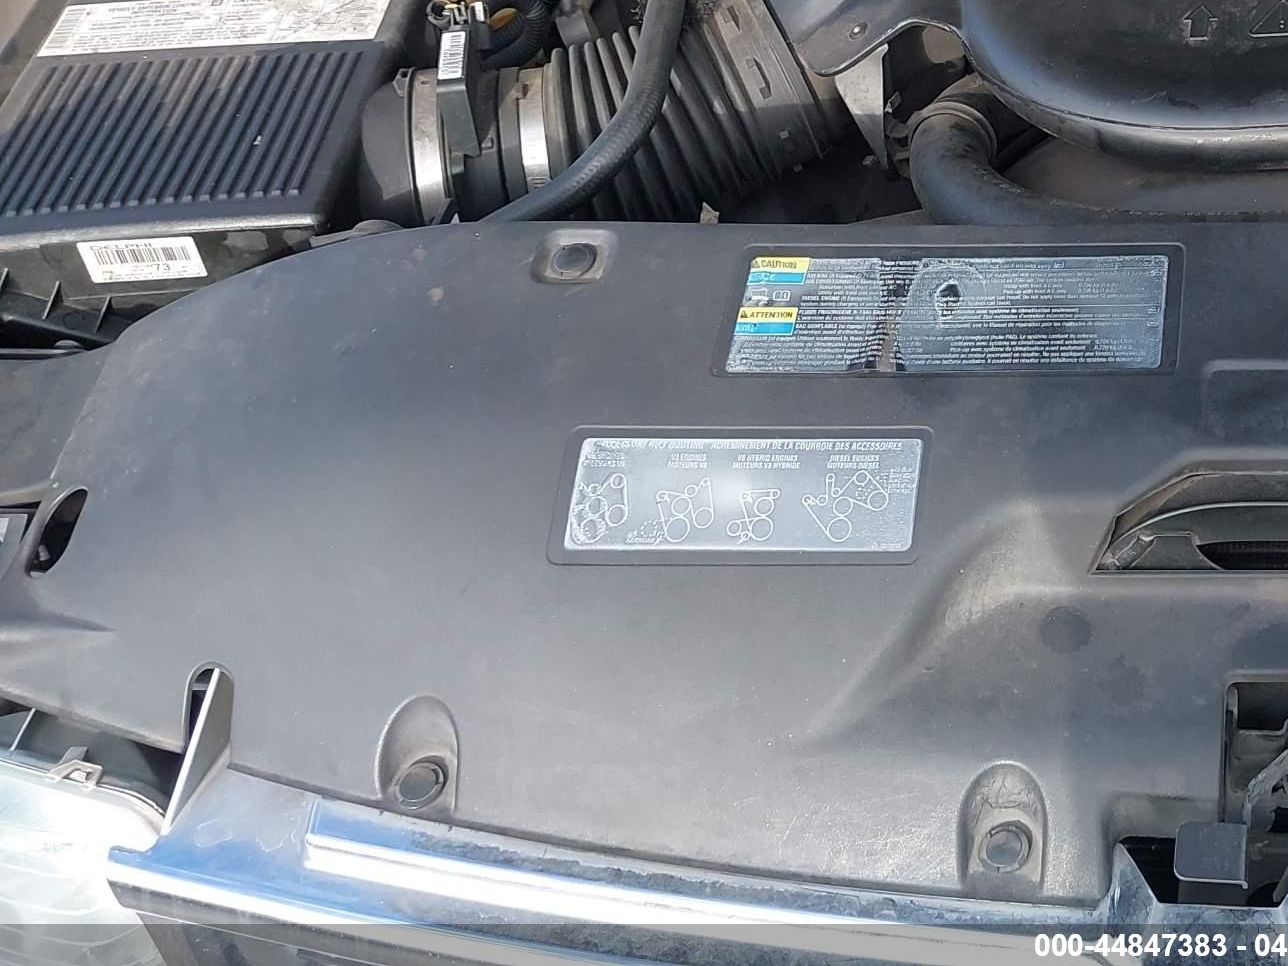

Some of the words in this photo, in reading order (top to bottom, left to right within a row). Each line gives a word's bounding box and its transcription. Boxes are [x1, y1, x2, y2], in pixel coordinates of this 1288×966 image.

[90, 242, 152, 251] DELPHI
[761, 260, 798, 270] CAUTION
[749, 311, 793, 320] ATTENTION
[710, 441, 770, 451] ACHEMINEMENT
[771, 441, 782, 451] DE
[783, 441, 793, 451] LA
[834, 441, 850, 451] DES
[851, 441, 904, 451] ACCESSOIRES
[829, 454, 851, 462] DIESEL
[732, 461, 763, 469] MOTEURS
